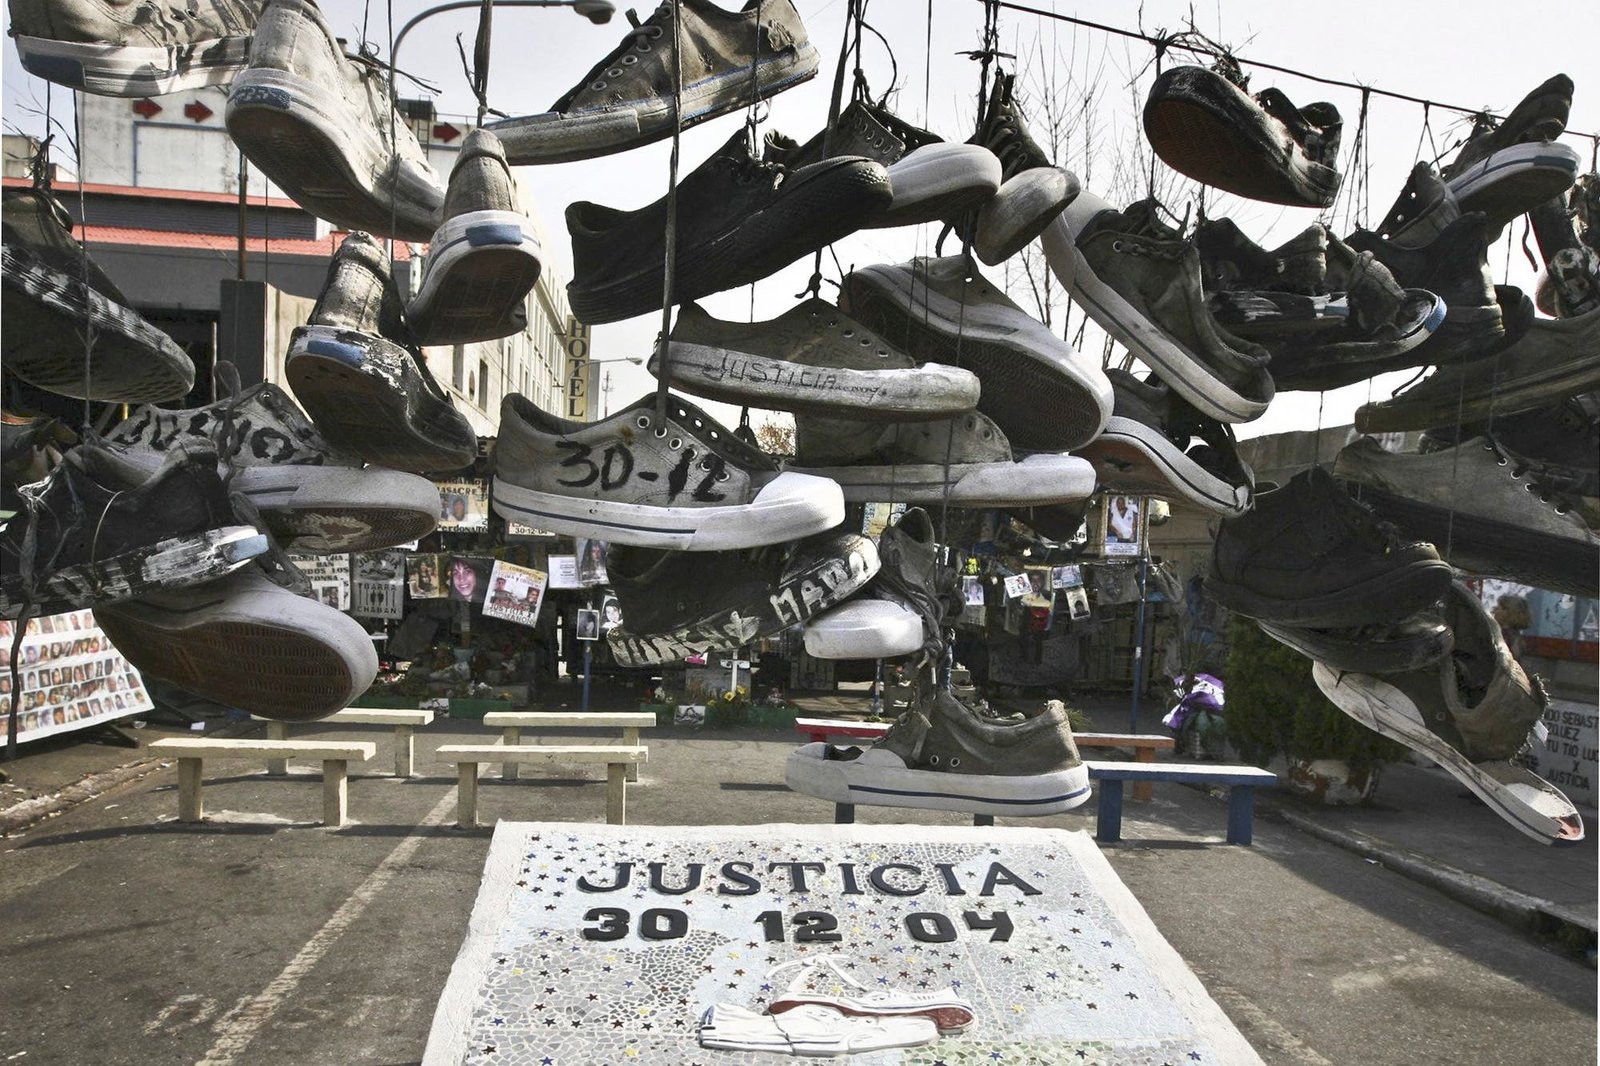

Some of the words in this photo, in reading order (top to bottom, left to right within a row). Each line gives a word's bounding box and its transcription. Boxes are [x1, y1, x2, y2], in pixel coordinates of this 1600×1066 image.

[568, 319, 588, 417] HOTEL
[702, 351, 837, 389] JUSTICIA
[576, 861, 1044, 896] JUSTICIA
[580, 907, 690, 943] 30
[753, 910, 843, 944] 12
[904, 910, 1015, 944] 04
